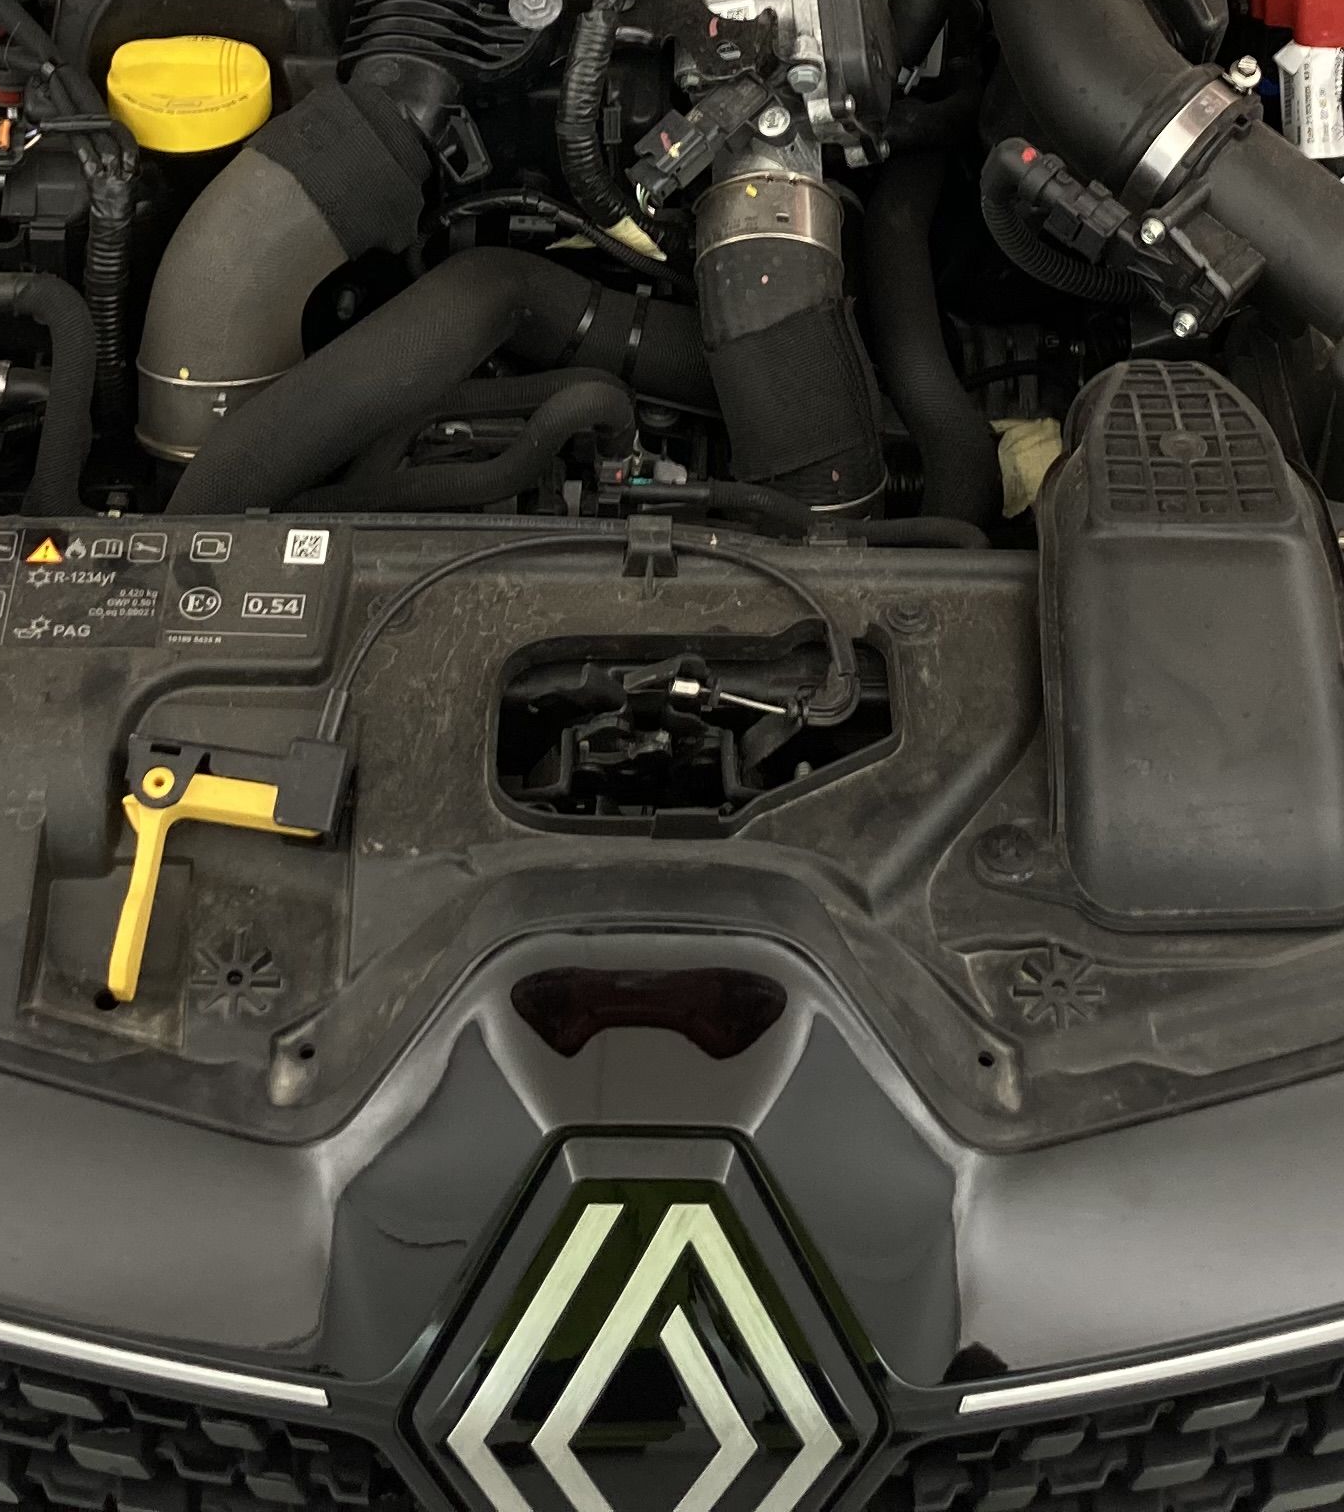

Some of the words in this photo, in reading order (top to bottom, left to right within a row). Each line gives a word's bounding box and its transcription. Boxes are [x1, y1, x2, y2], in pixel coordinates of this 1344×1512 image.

[53, 571, 117, 587] R-1234yf
[146, 590, 159, 598] kg
[106, 598, 131, 606] GWP
[248, 597, 299, 615] 0,54
[52, 624, 91, 638] PAG
